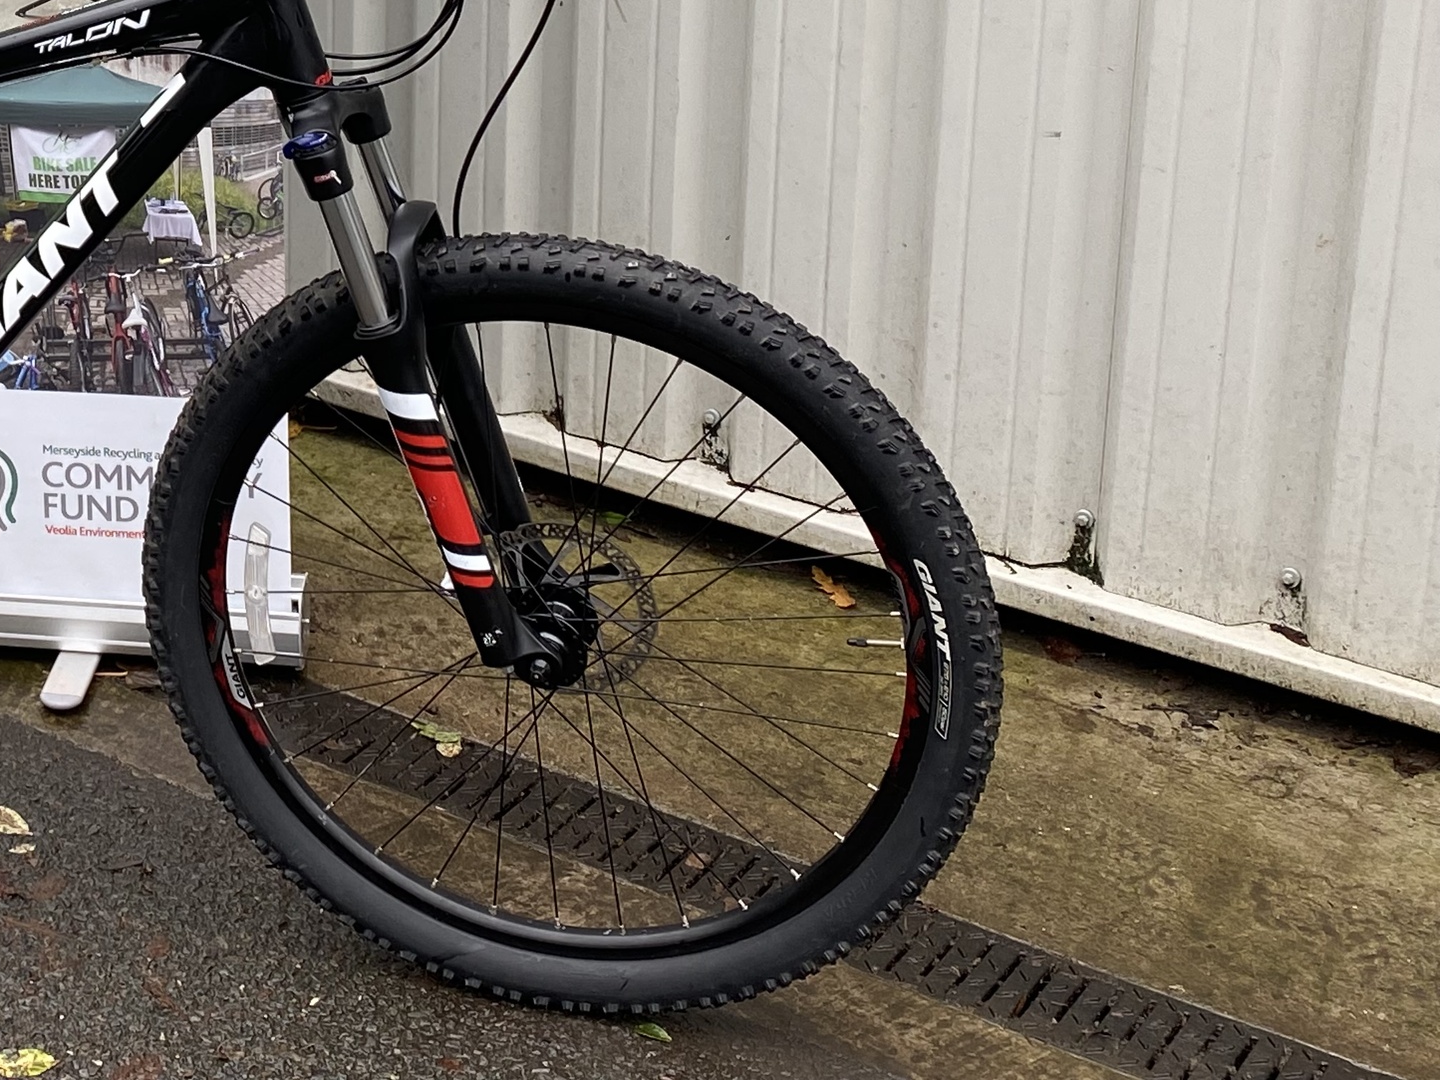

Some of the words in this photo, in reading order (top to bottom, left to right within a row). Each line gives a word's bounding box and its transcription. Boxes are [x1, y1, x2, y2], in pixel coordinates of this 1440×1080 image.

[34, 9, 150, 53] TALON
[33, 156, 62, 172] BIKE
[29, 173, 60, 188] HERE
[42, 444, 101, 458] Merseyside
[103, 448, 152, 462] Recycling
[44, 492, 139, 522] FUND
[45, 525, 77, 536] Veolia
[913, 558, 951, 661] GIANT
[226, 653, 245, 699] GIANT
